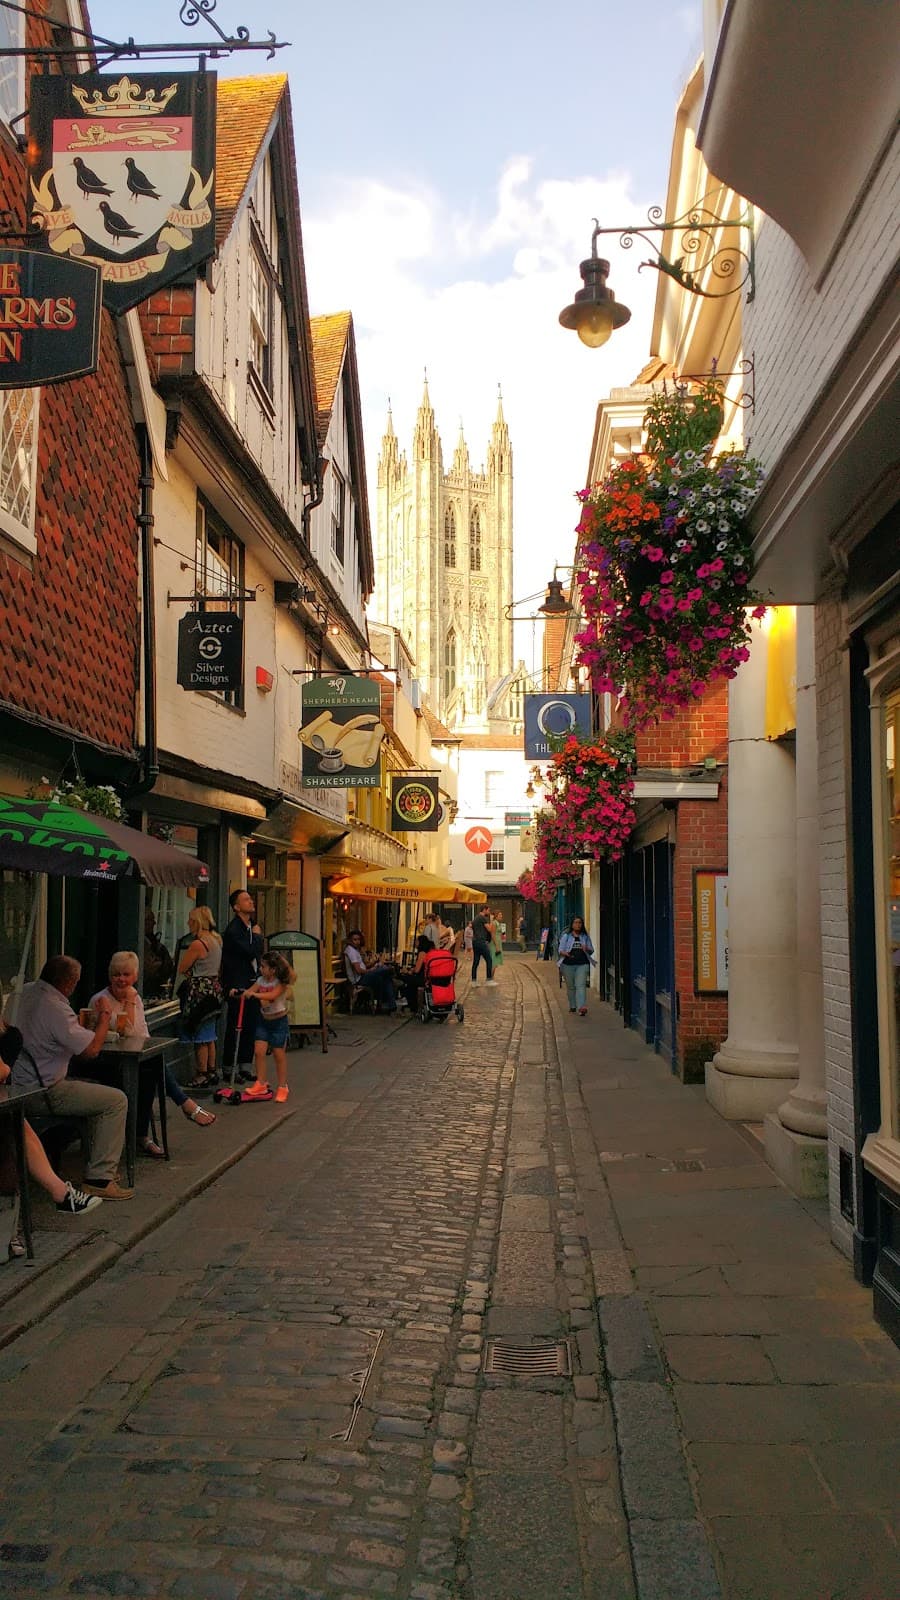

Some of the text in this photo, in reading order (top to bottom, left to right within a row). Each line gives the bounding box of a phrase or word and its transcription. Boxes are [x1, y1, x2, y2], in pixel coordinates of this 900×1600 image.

[0, 297, 76, 331] RMS
[187, 620, 233, 633] Aztec
[196, 662, 225, 673] Silver
[190, 673, 229, 685] Designs
[303, 696, 379, 705] SHEPHERD NEAME
[306, 776, 376, 786] SHAKESPEARE
[364, 886, 419, 898] CLUB BURRITO
[701, 889, 712, 978] Roman Museum
